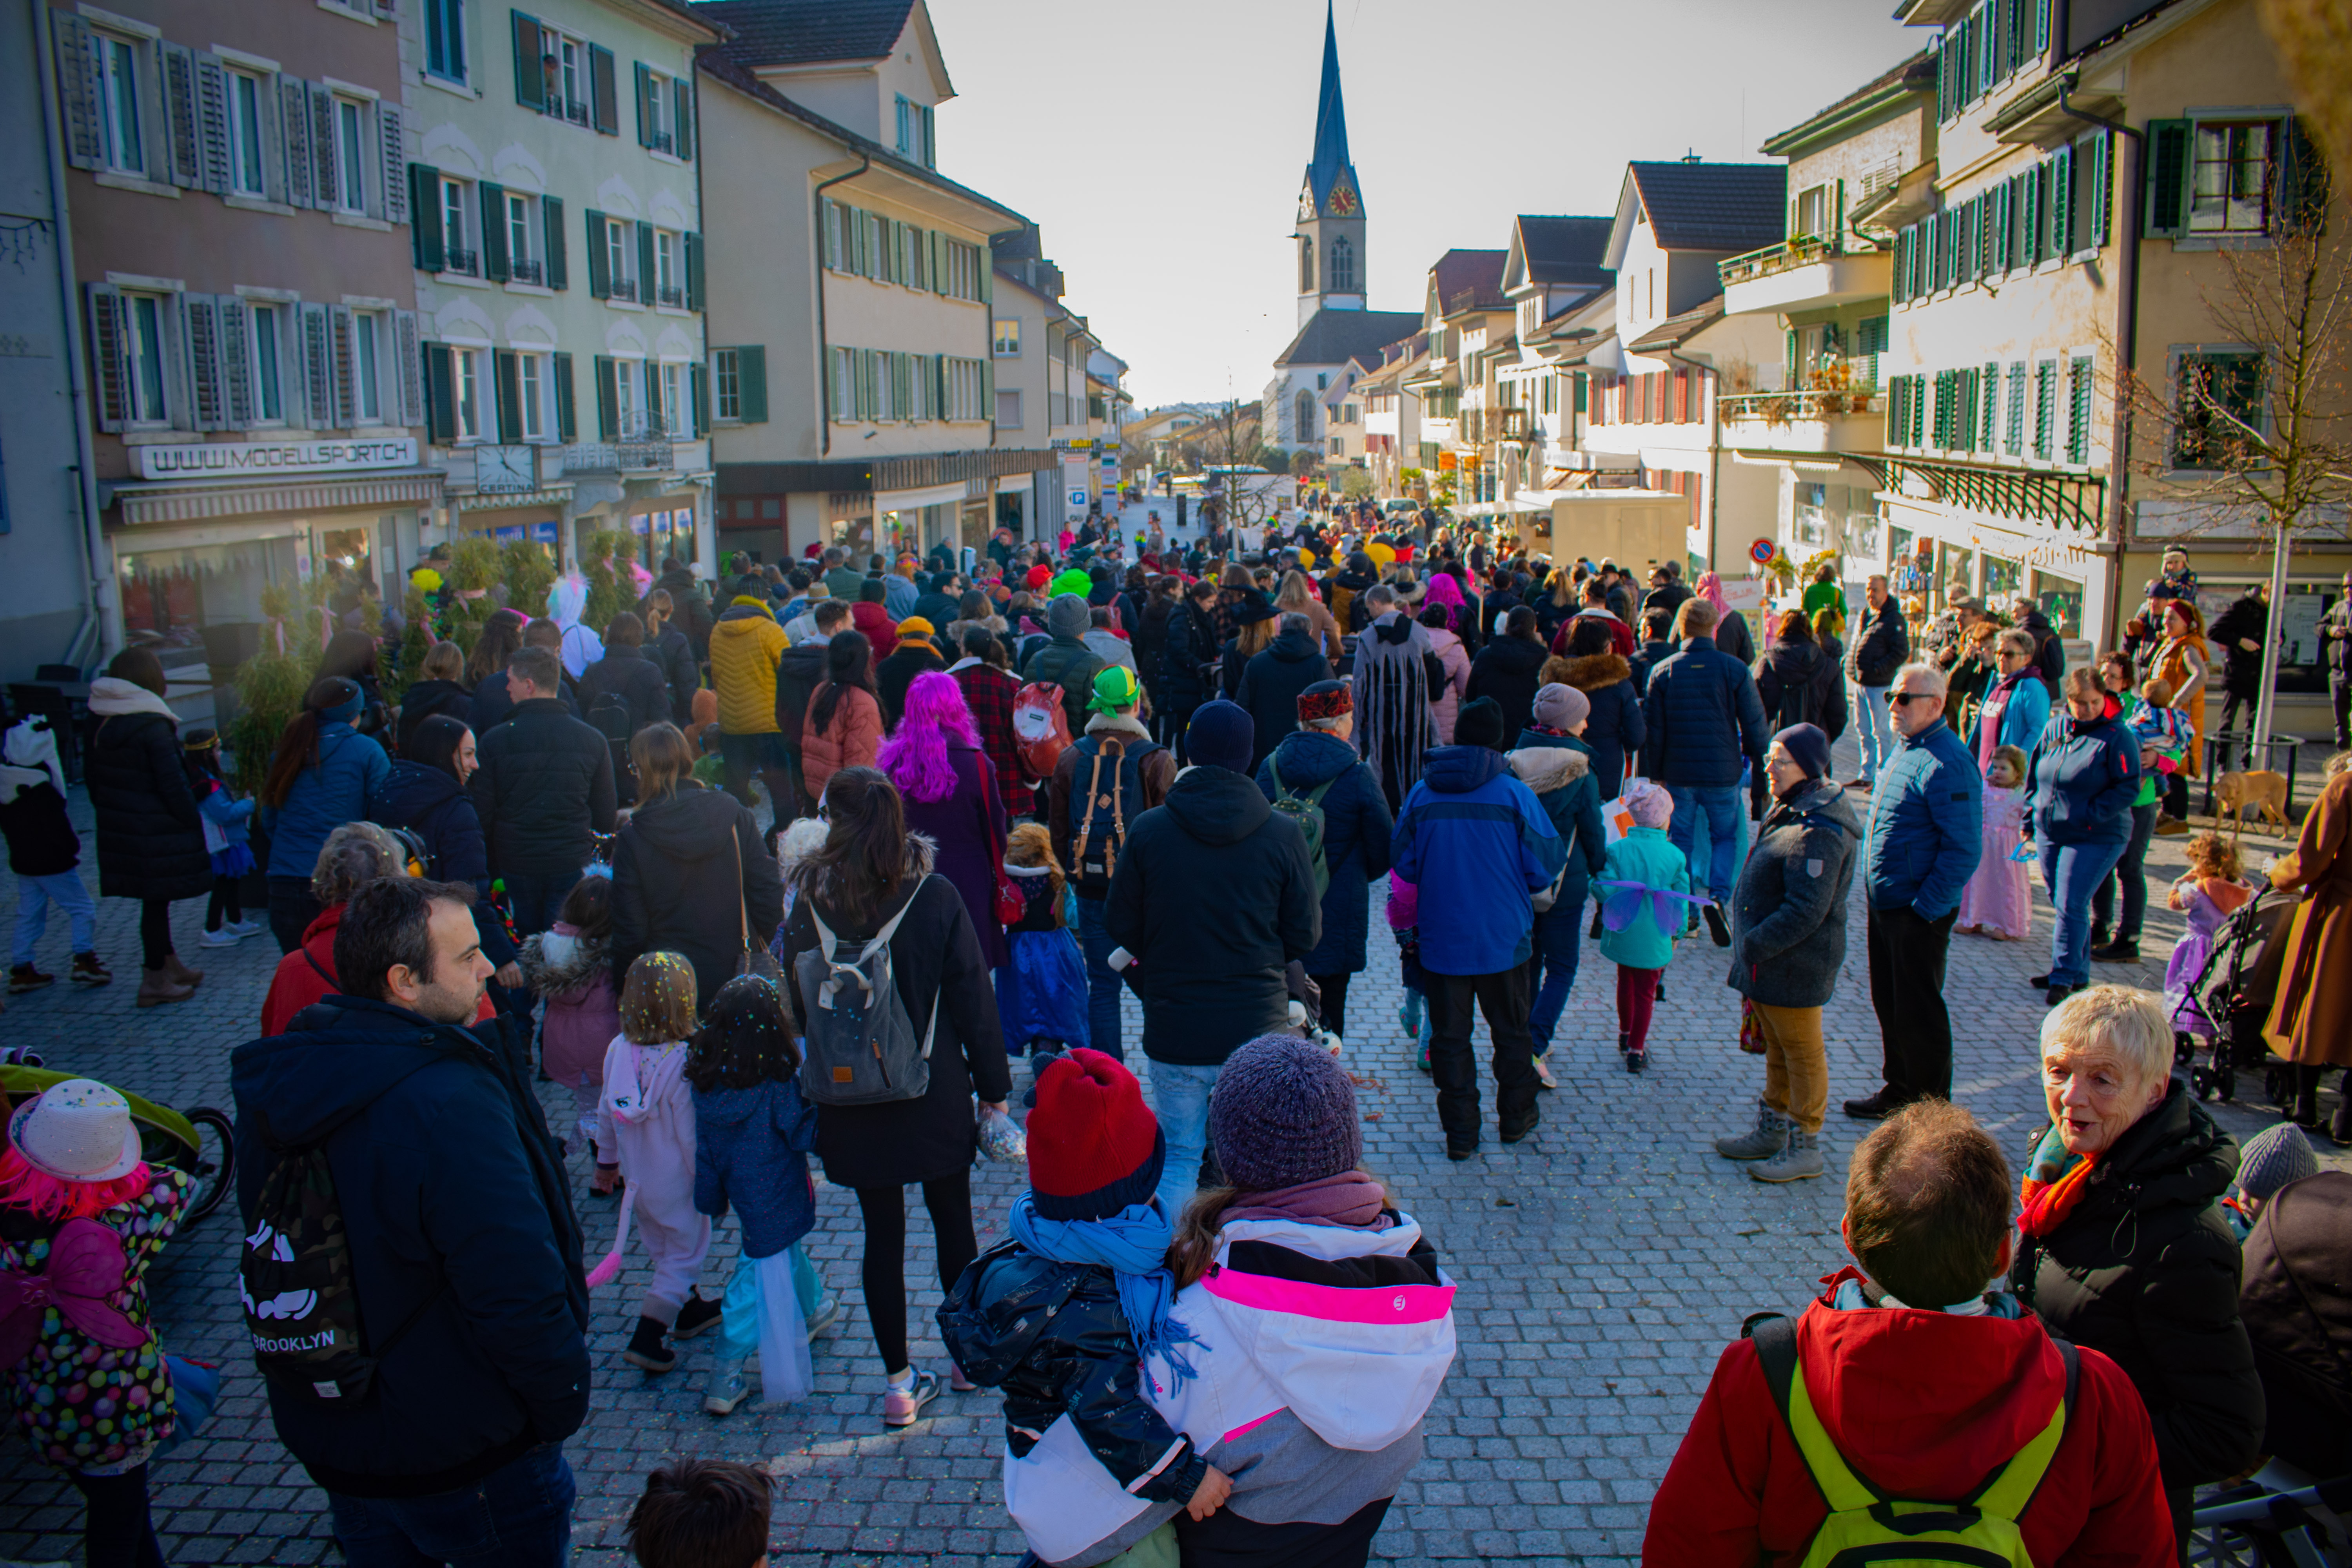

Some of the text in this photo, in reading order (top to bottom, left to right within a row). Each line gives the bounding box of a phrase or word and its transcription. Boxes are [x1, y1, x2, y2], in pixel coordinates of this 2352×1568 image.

[153, 443, 409, 472] WWW.MODELLSPORT.CH
[480, 484, 534, 492] CERTINA
[1075, 494, 1083, 503] P
[252, 1329, 335, 1352] BROOKLYN
